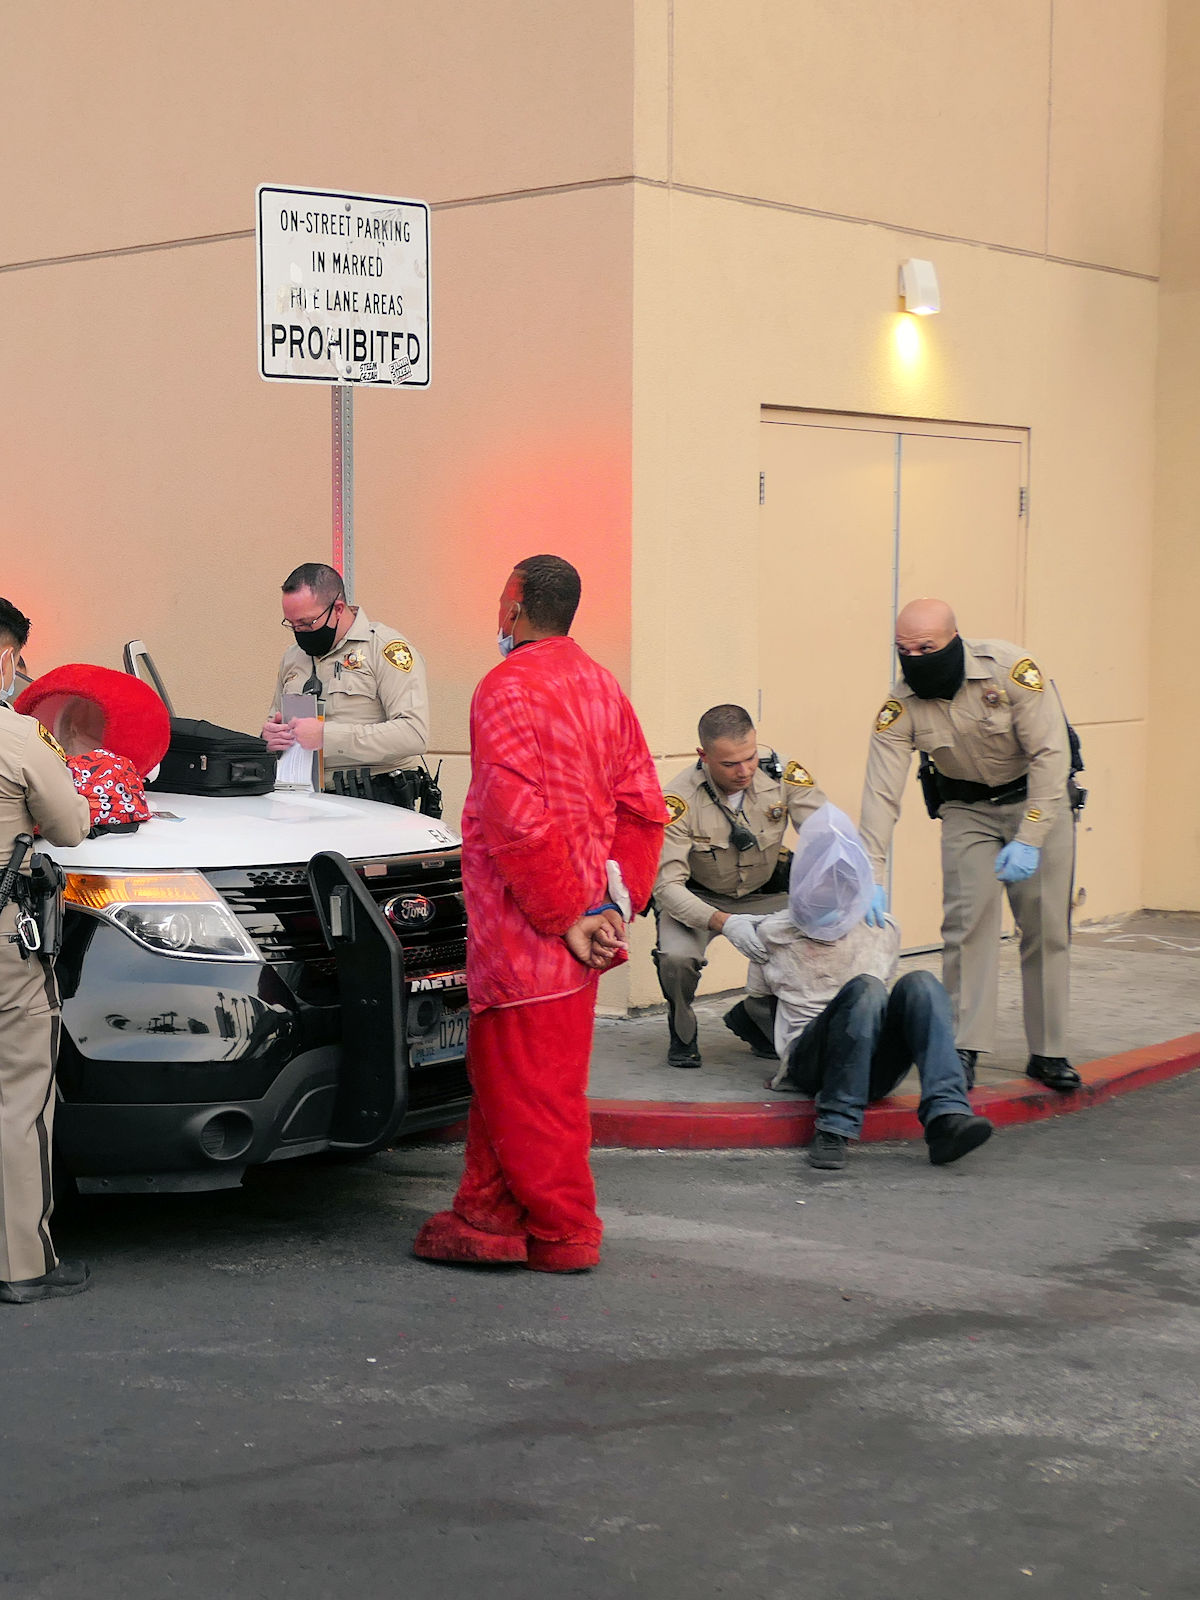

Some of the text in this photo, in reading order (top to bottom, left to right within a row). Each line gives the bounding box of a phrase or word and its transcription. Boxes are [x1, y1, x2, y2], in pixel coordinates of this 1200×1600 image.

[280, 209, 411, 243] ON-STREET PARKING
[312, 251, 383, 278] IN MARKED
[326, 289, 359, 313] LANE
[363, 293, 403, 316] AREAS
[271, 323, 421, 365] PROHIBITED
[401, 899, 429, 919] Ford
